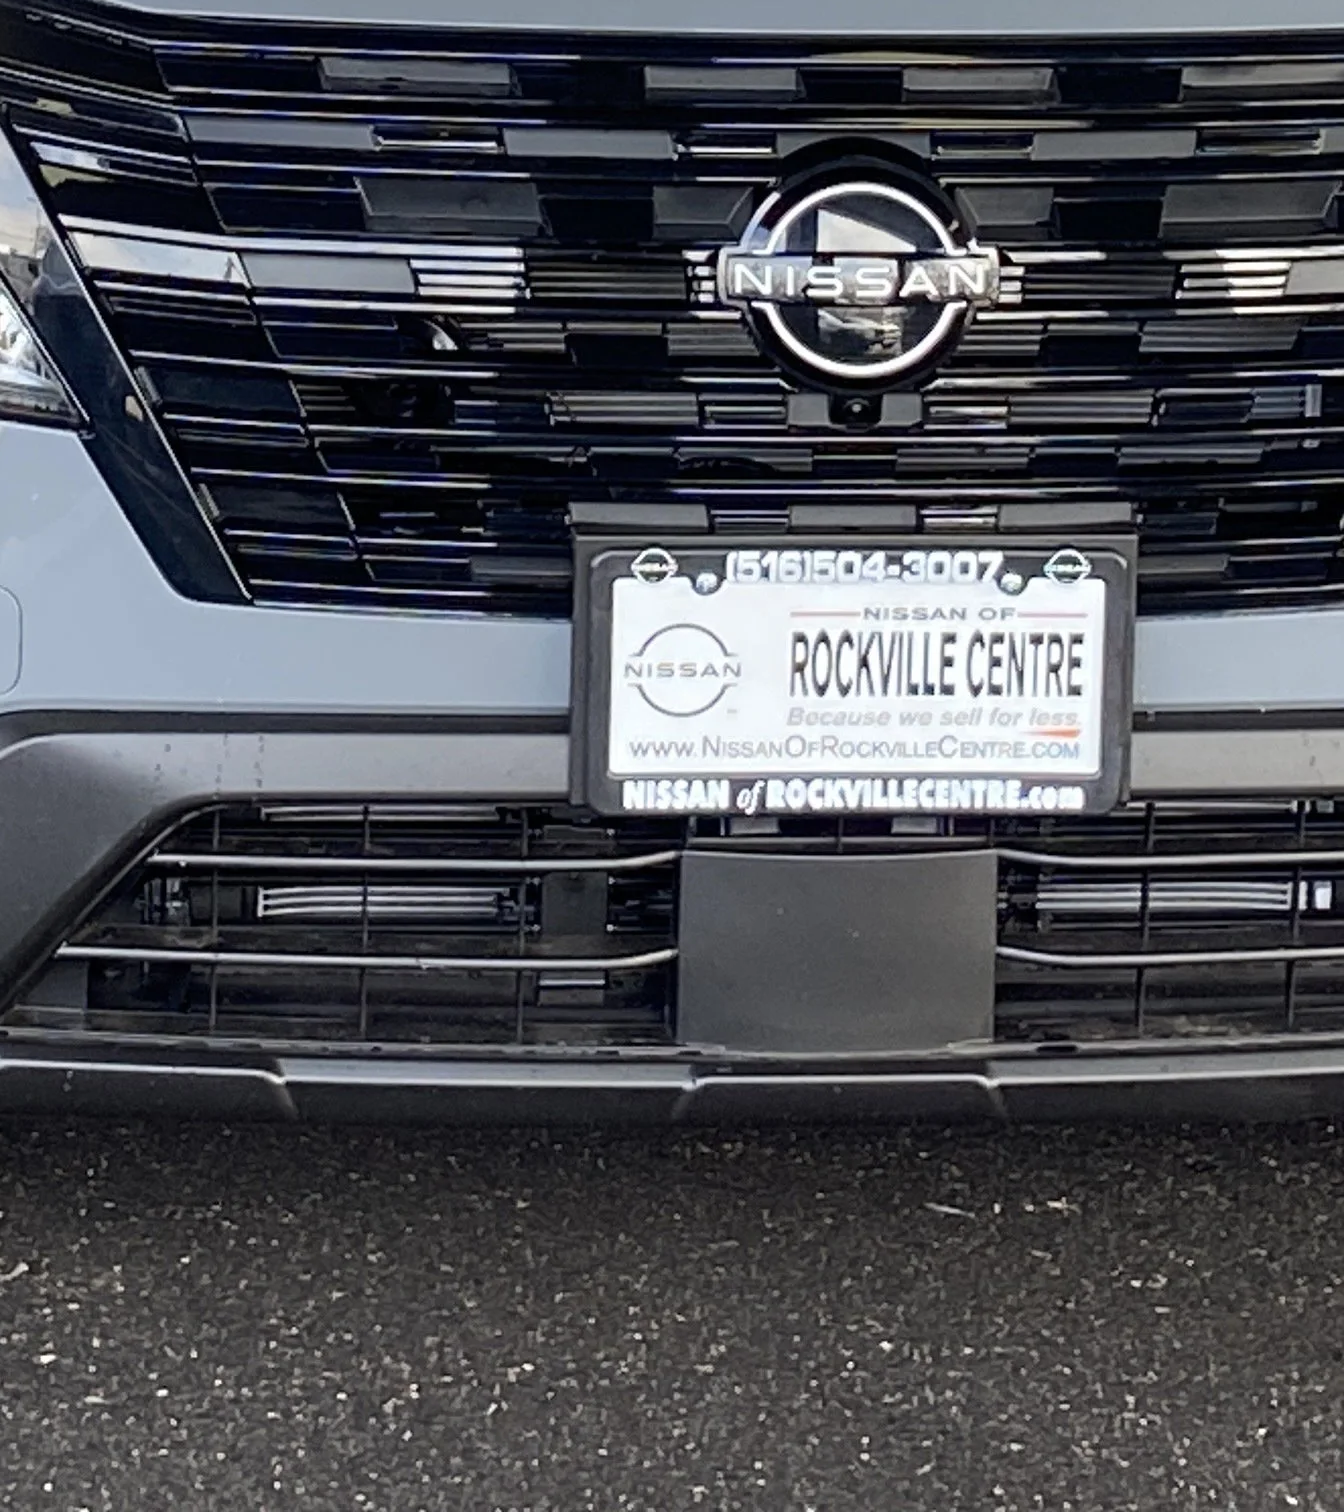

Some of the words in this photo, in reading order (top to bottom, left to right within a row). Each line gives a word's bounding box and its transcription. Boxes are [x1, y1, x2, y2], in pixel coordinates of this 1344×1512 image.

[733, 262, 987, 298] NISSAN
[725, 550, 1004, 583] (516)504-3007
[862, 607, 968, 621] NISSAN
[978, 607, 1016, 621] OF
[624, 662, 742, 679] NISSAN
[789, 630, 956, 698] ROCKVILLE
[966, 630, 1085, 698] CENTRE
[786, 707, 891, 727] Because
[899, 711, 933, 727] we
[939, 707, 983, 727] sell
[989, 707, 1023, 727] for
[622, 779, 731, 810] NISSAN
[736, 780, 766, 816] of
[766, 778, 1086, 810] ROCKVILLECENTRE.com
